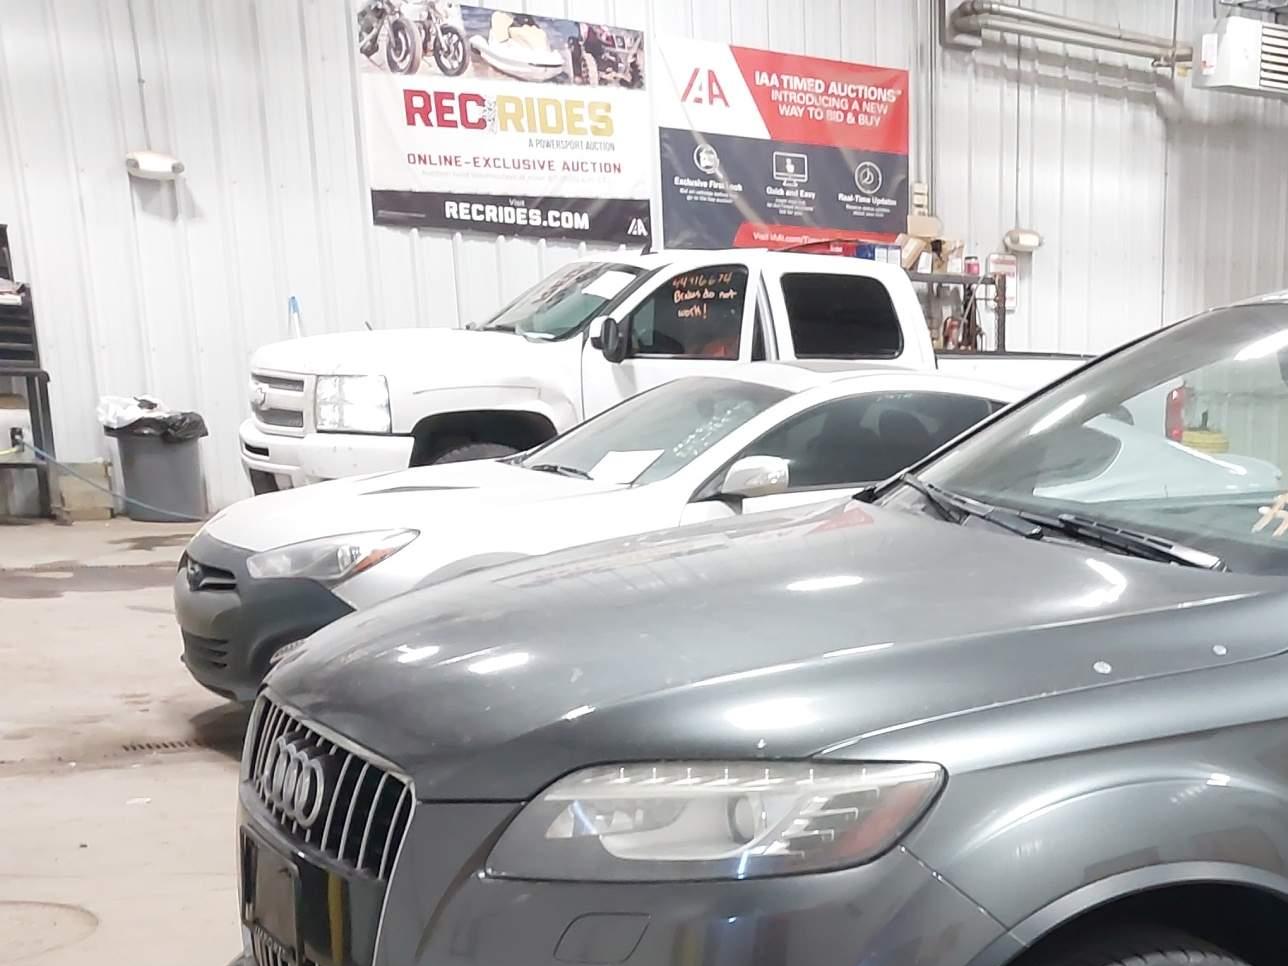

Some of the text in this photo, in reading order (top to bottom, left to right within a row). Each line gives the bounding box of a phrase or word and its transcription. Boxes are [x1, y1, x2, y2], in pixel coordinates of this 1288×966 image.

[755, 71, 779, 88] IAA
[780, 75, 823, 94] TIMED
[772, 89, 888, 115] INTRODUCING A NEW
[403, 89, 615, 137] REC RIDES
[778, 104, 881, 127] WAY TO BID & BUY
[528, 138, 615, 151] A POWERSPORT AUCTION
[407, 153, 622, 174] ONLINE-EXCLUSIVE AUCTION
[674, 176, 708, 188] Exclusive
[766, 186, 816, 200] Quick and Easy
[838, 192, 870, 203] Real-Time
[509, 198, 525, 207] Visit
[445, 201, 590, 230] RECRIDES.COM
[753, 231, 769, 241] Visit
